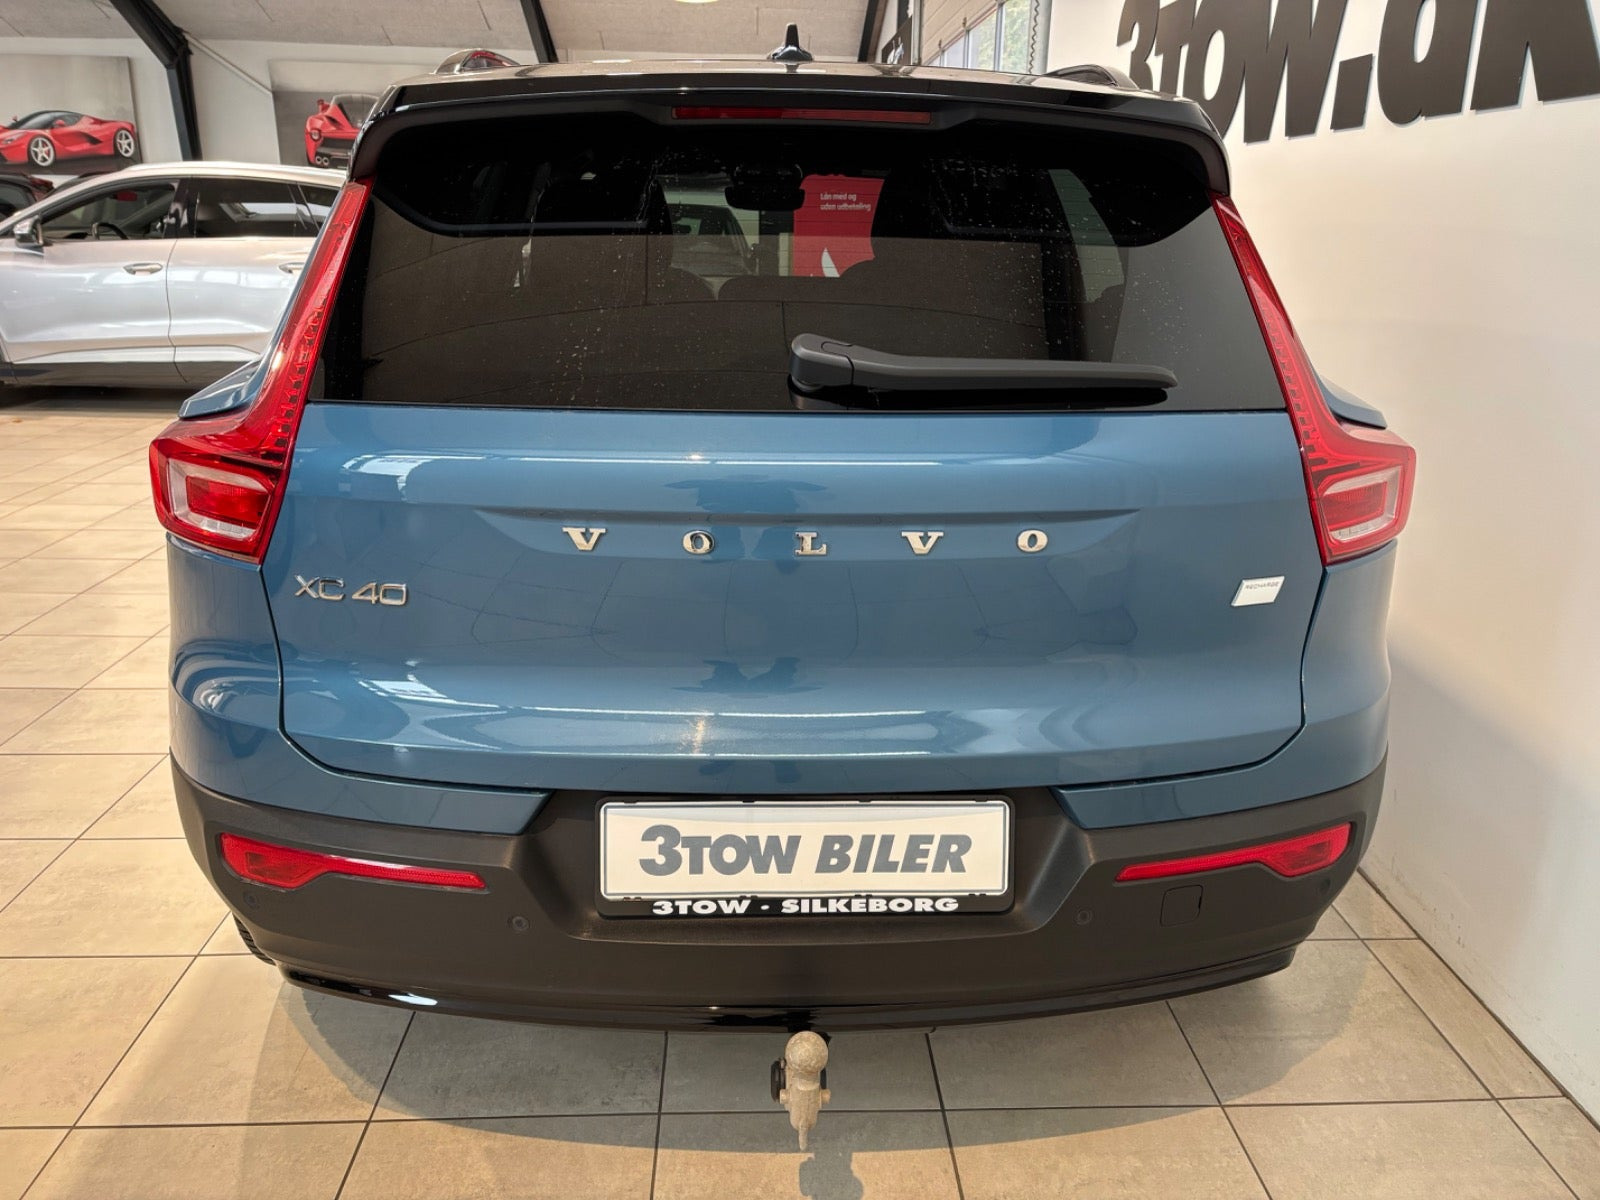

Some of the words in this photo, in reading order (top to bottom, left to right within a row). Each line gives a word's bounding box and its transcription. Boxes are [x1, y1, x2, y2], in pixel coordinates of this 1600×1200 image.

[562, 527, 1049, 556] VOLVO
[294, 574, 345, 601] XC
[351, 581, 407, 606] 40
[638, 824, 802, 876] 3TOW
[815, 834, 972, 873] BILER
[652, 899, 751, 915] 3TOW
[781, 897, 959, 913] SILKEBORG
